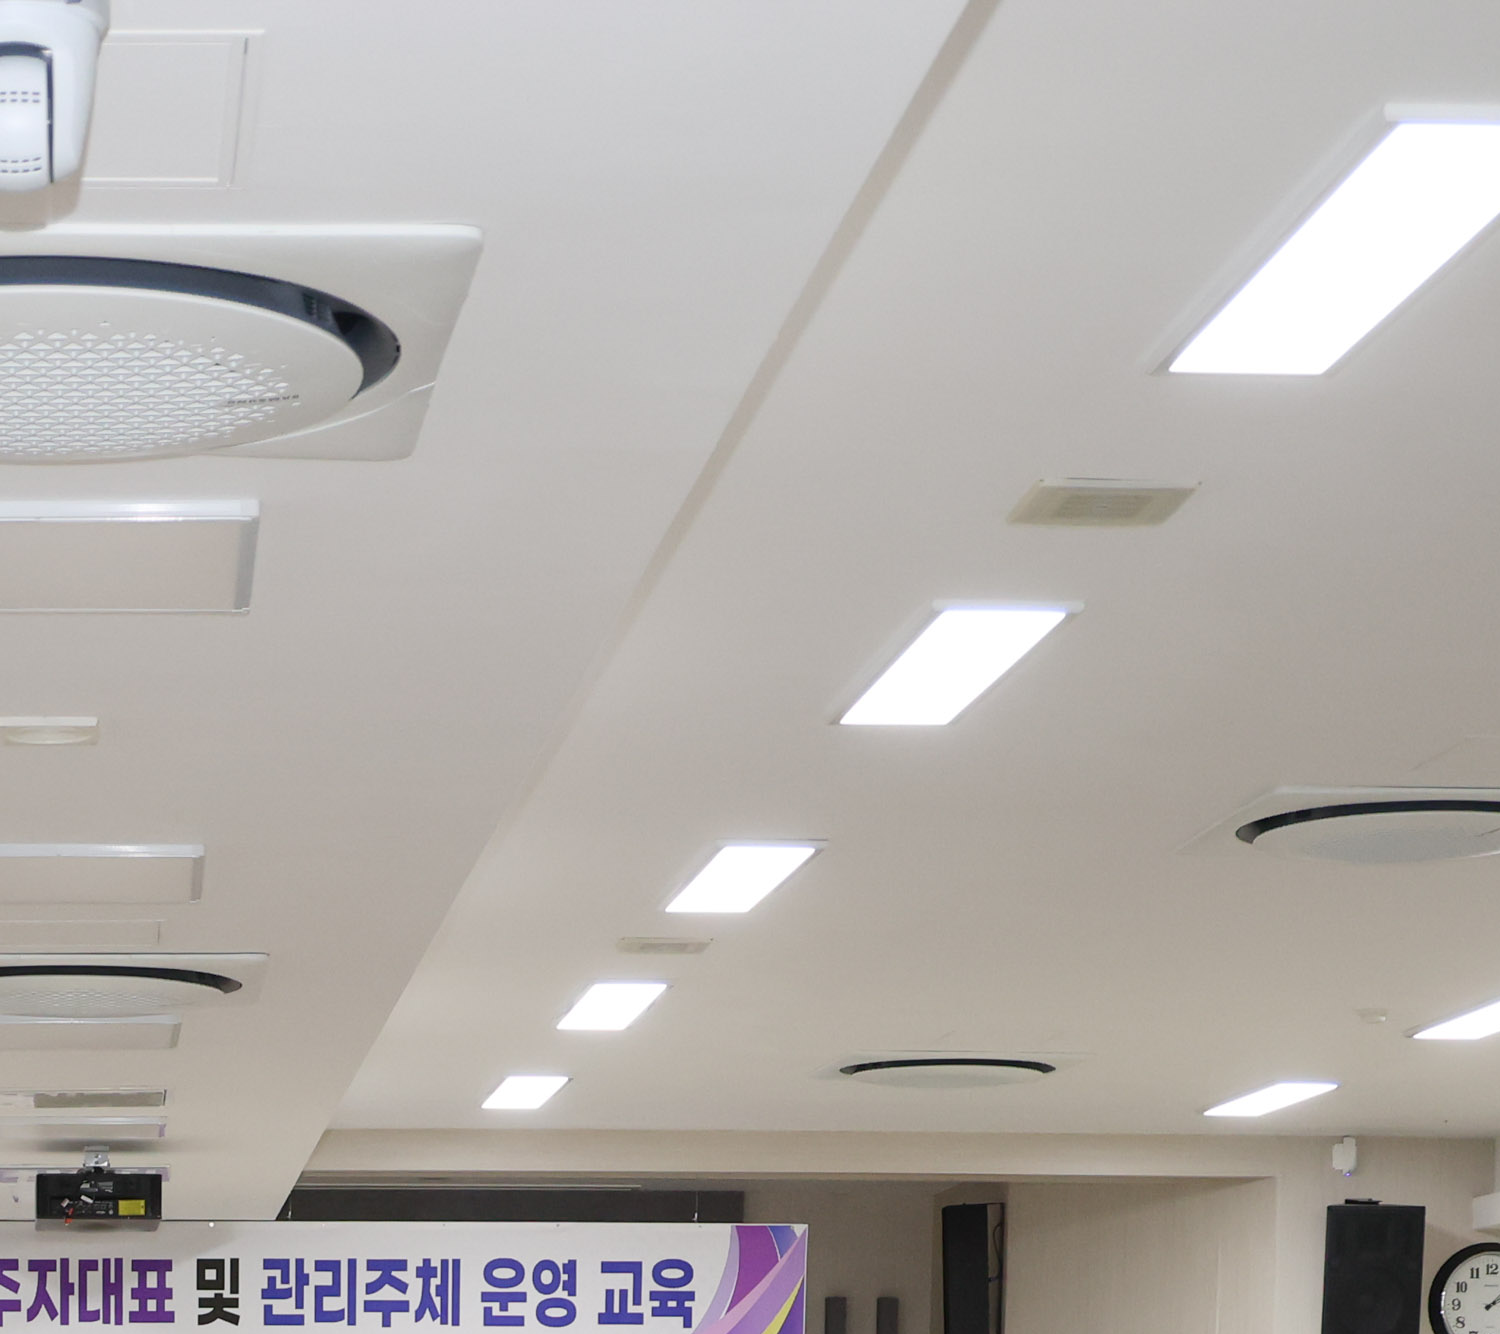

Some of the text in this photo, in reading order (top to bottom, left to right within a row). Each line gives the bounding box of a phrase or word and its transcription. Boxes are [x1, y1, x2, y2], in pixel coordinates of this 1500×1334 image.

[1470, 1267, 1480, 1279] 11
[1486, 1263, 1499, 1275] 12
[195, 1257, 241, 1327] 및
[260, 1257, 461, 1328] 관리주체
[480, 1257, 577, 1328] 운영
[597, 1258, 696, 1329] 교육
[1456, 1281, 1468, 1293] 10
[1451, 1298, 1461, 1311] 9
[1455, 1316, 1466, 1329] 8
